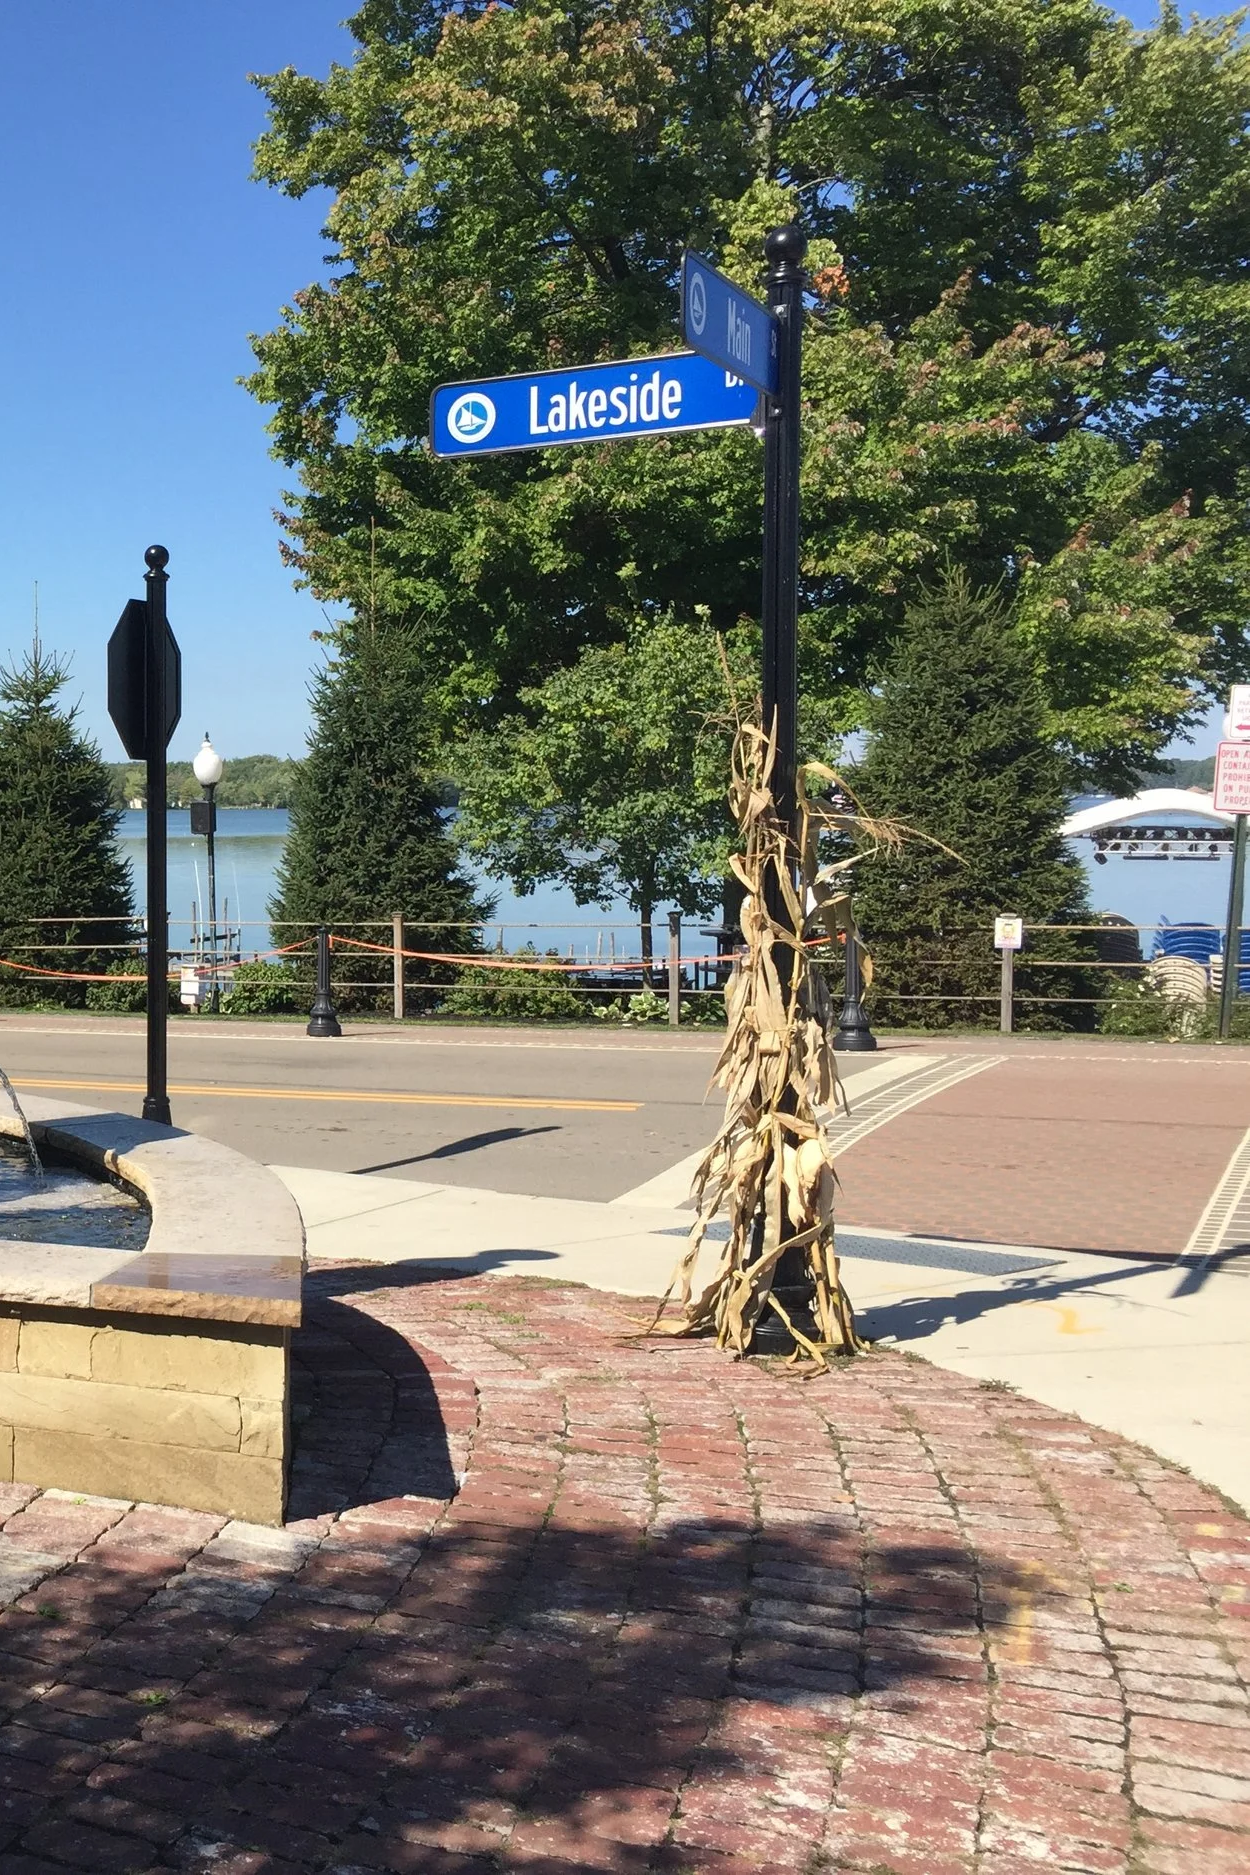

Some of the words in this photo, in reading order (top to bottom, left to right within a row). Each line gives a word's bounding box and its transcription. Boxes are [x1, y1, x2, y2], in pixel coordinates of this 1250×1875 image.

[727, 297, 751, 366] Main
[529, 370, 682, 435] Lakeside
[1221, 750, 1239, 758] OPEN
[1223, 784, 1233, 793] ON
[1224, 795, 1250, 805] PROPE
